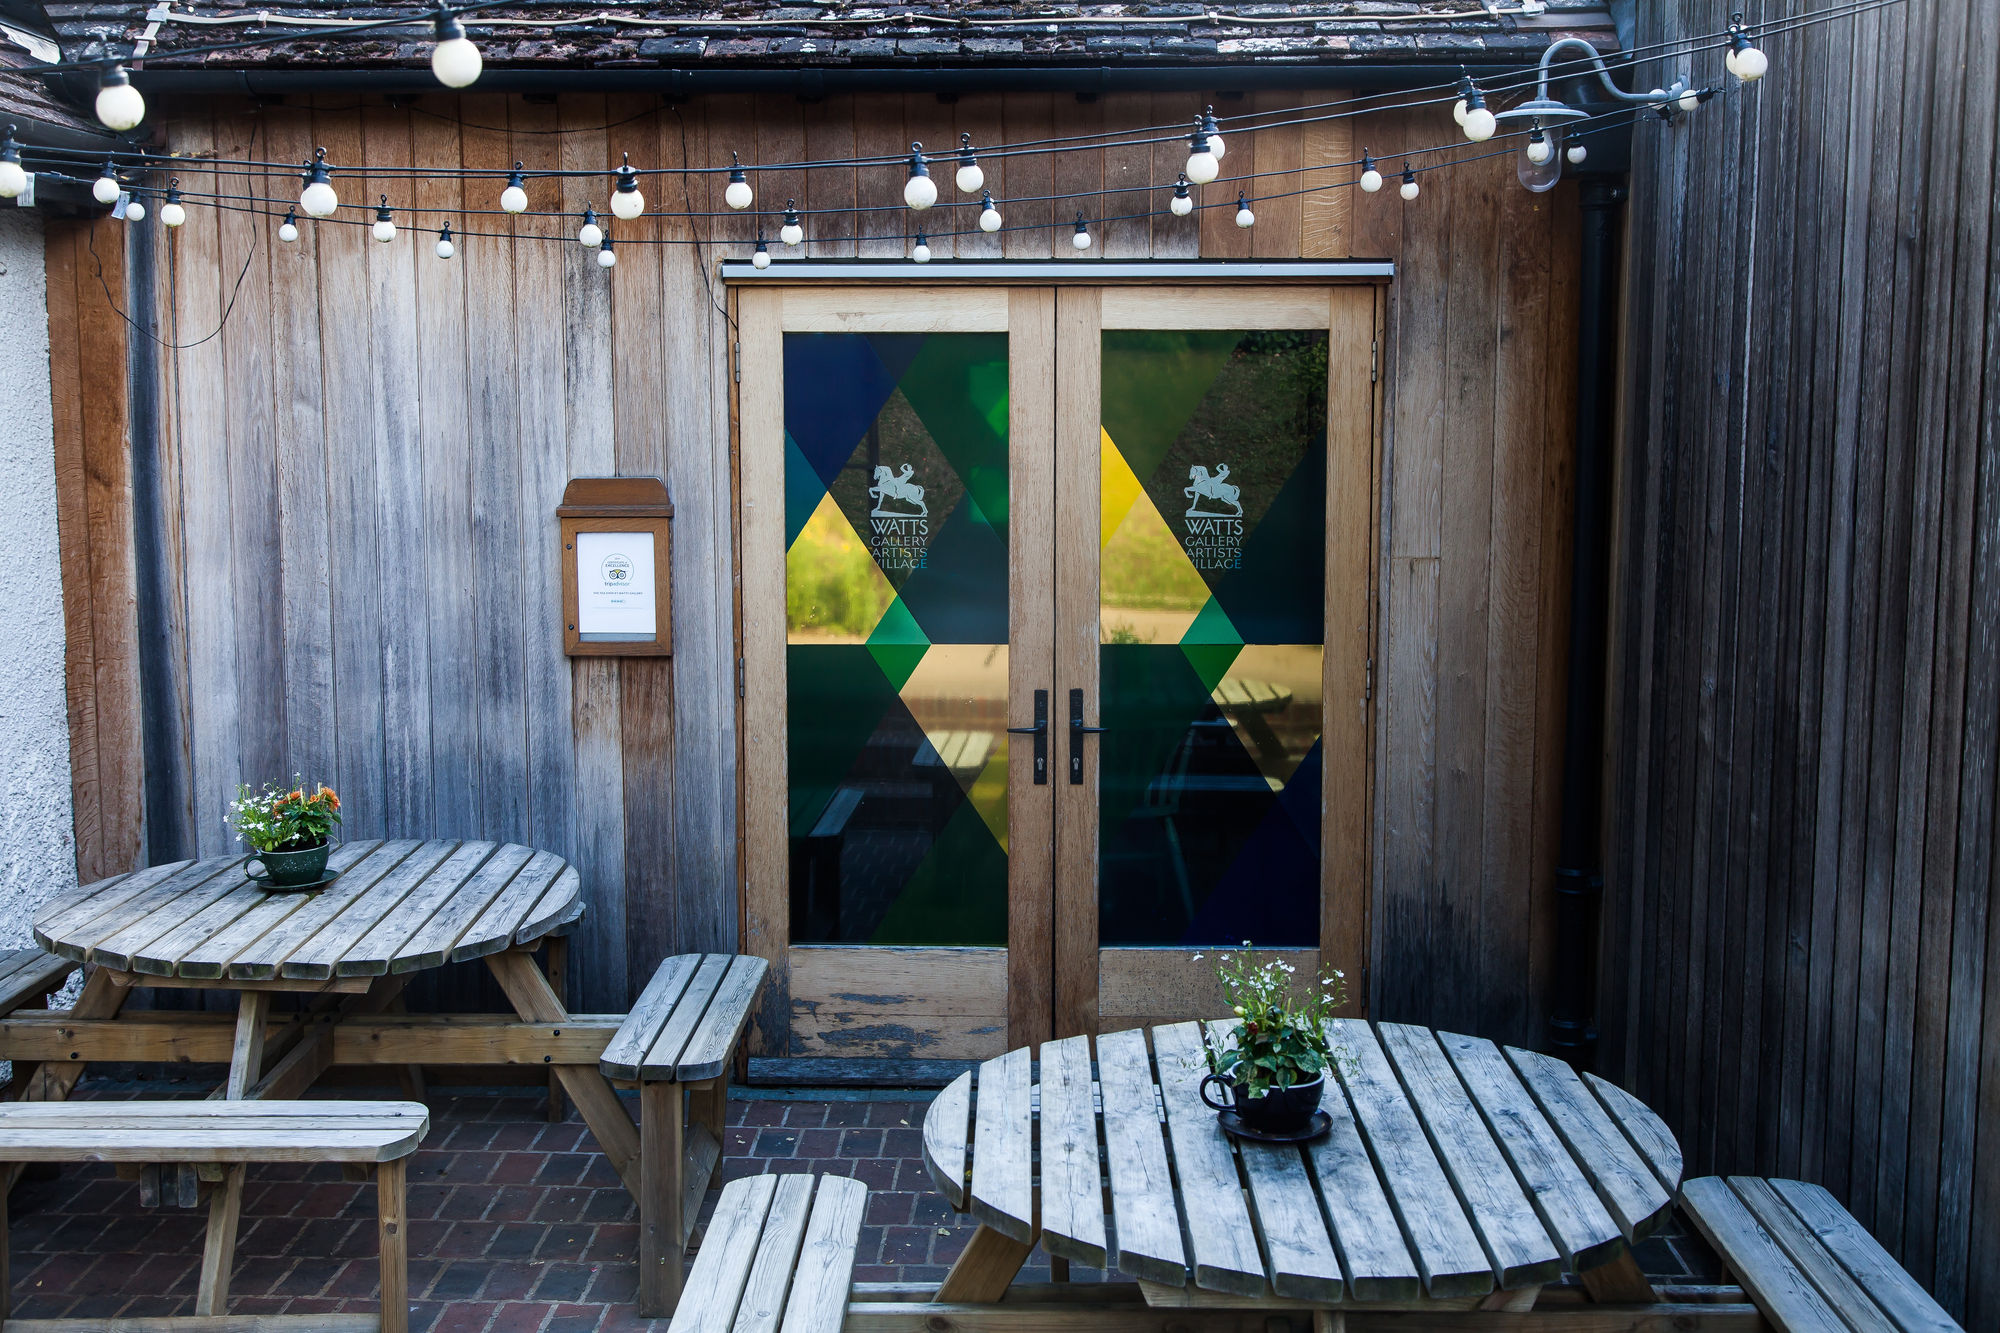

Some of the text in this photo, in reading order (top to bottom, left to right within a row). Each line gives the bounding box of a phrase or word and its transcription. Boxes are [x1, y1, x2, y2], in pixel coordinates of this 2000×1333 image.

[870, 518, 929, 535] WATTS
[1184, 518, 1244, 535] WATTS
[870, 536, 928, 547] GALLERY
[1185, 536, 1243, 547] GALLERY
[872, 547, 928, 558] ARTISTS
[1186, 547, 1242, 558] ARTISTS
